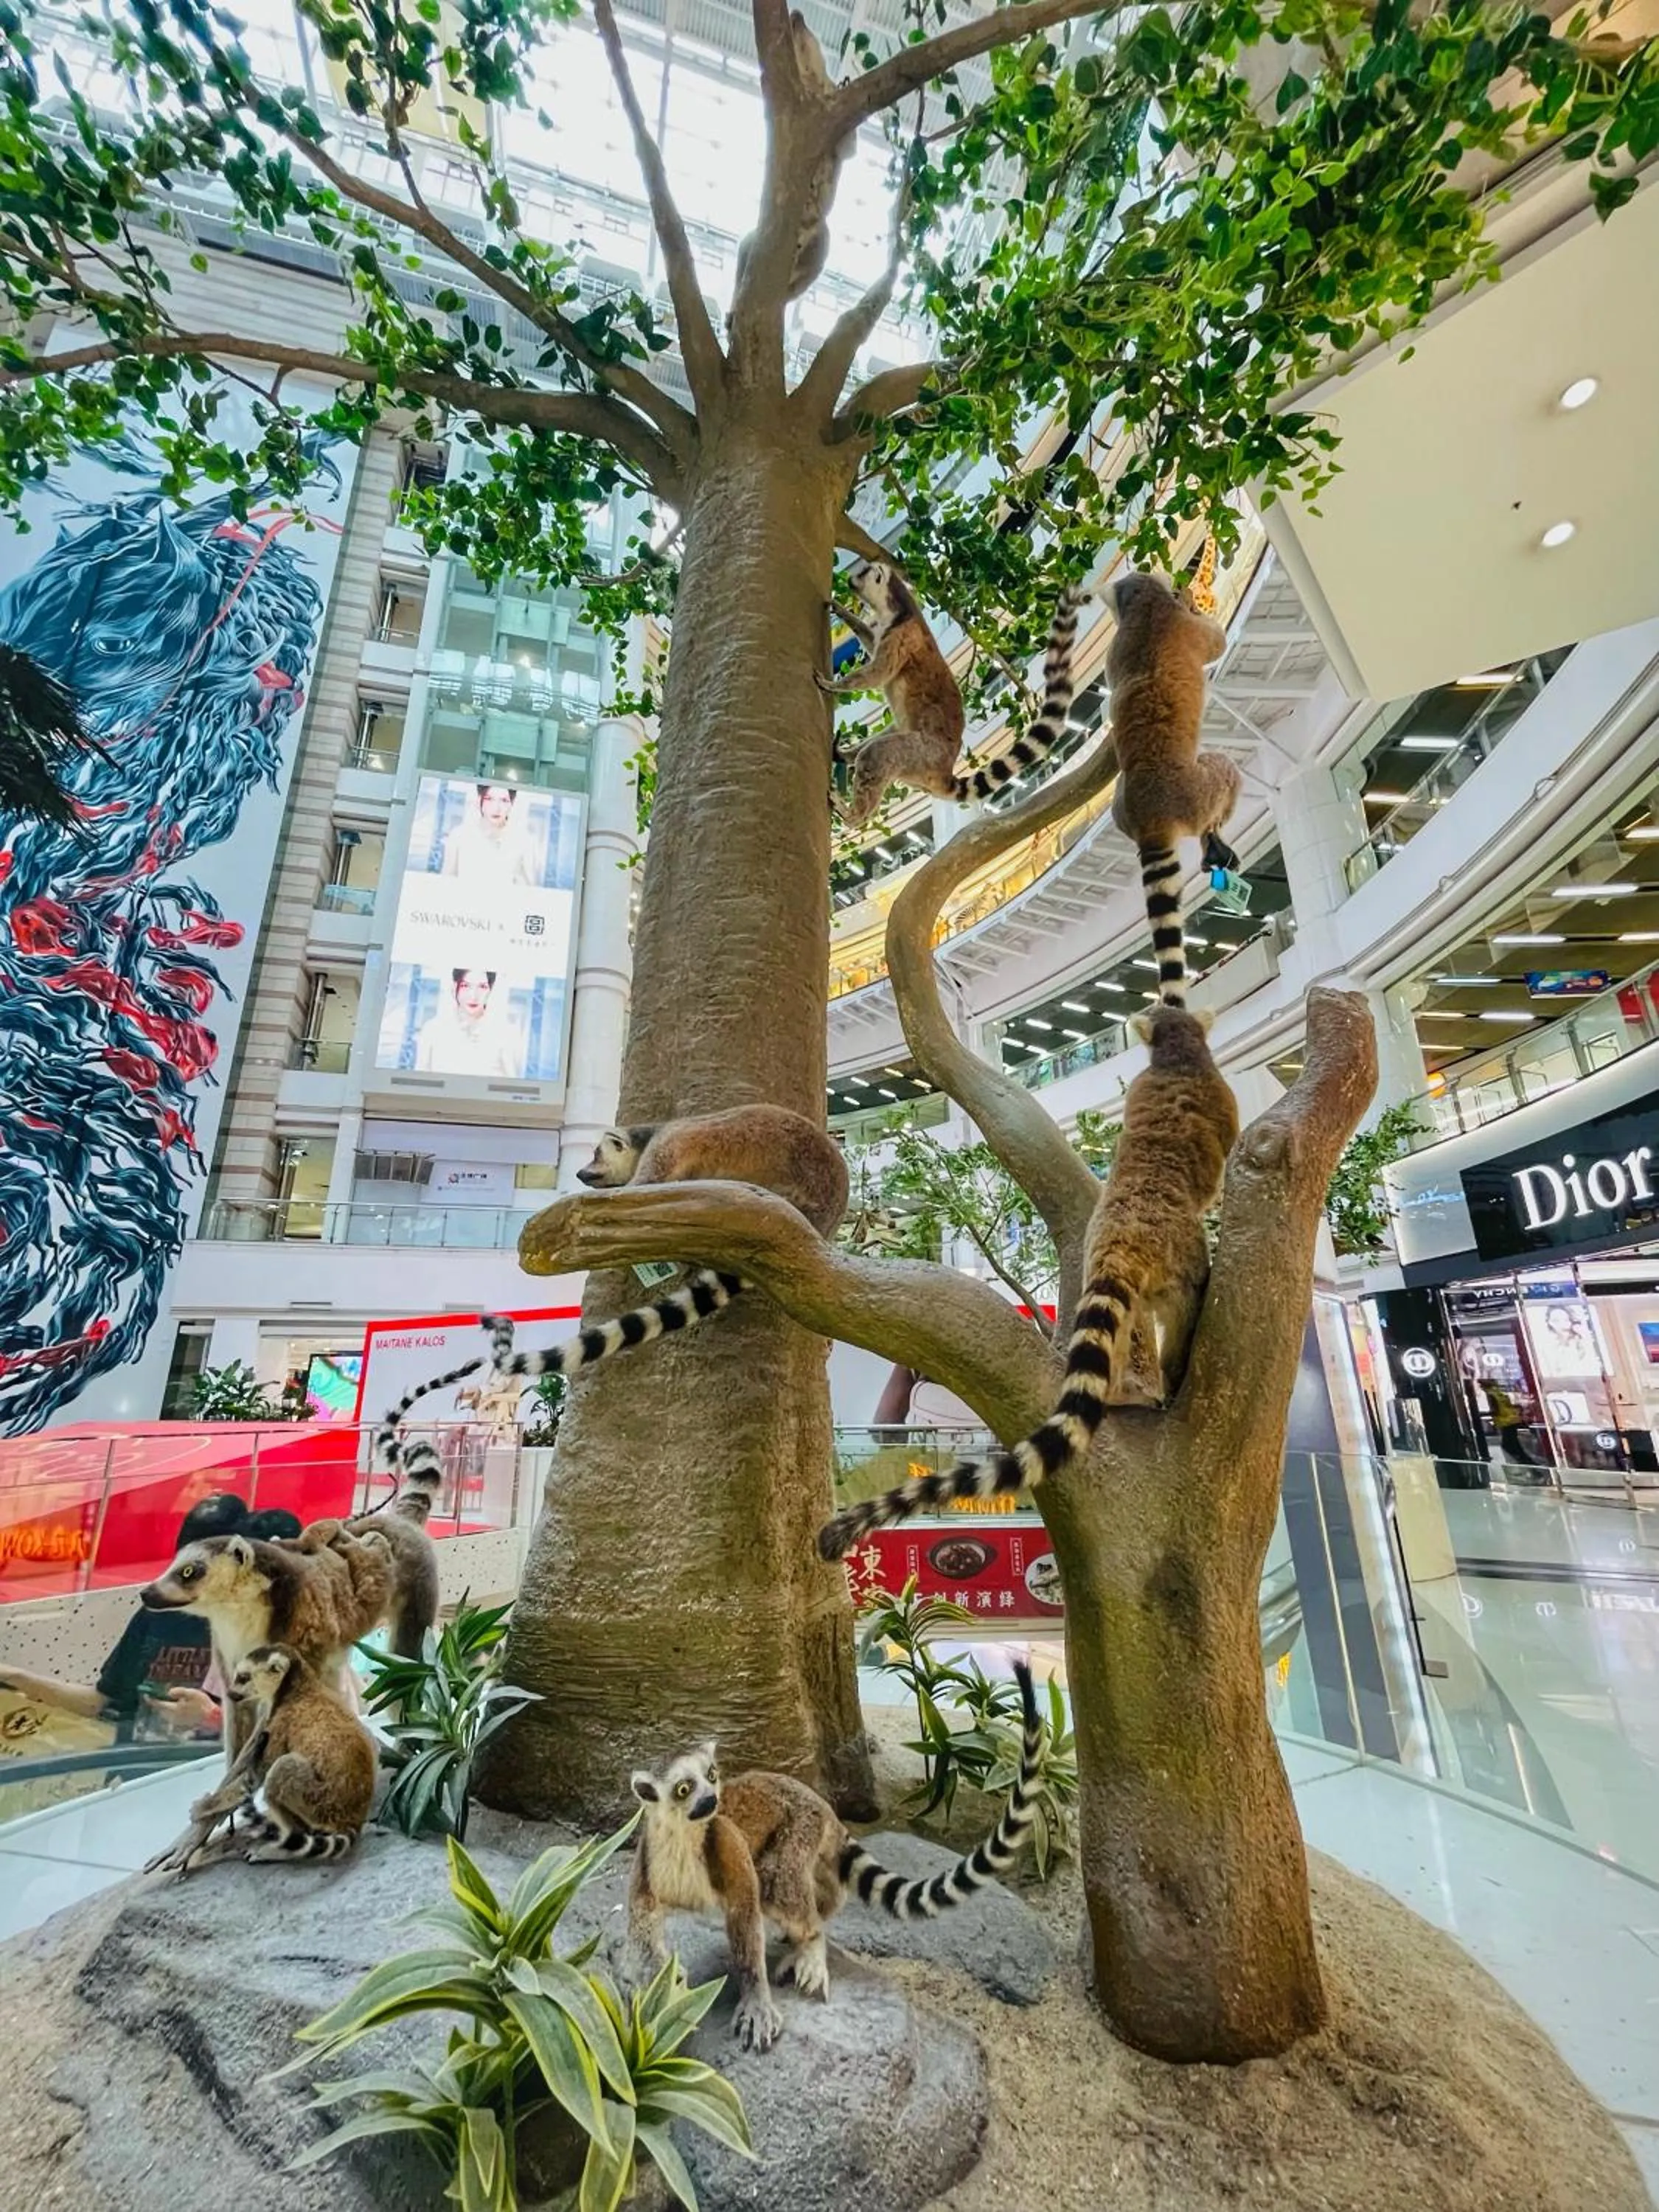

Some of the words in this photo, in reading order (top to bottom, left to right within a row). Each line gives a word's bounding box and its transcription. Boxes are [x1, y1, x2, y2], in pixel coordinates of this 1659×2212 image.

[410, 911, 491, 932] SWAROVSKI
[1512, 1147, 1655, 1231] Dior
[376, 1338, 412, 1349] MAITANE
[415, 1335, 445, 1347] KALOS
